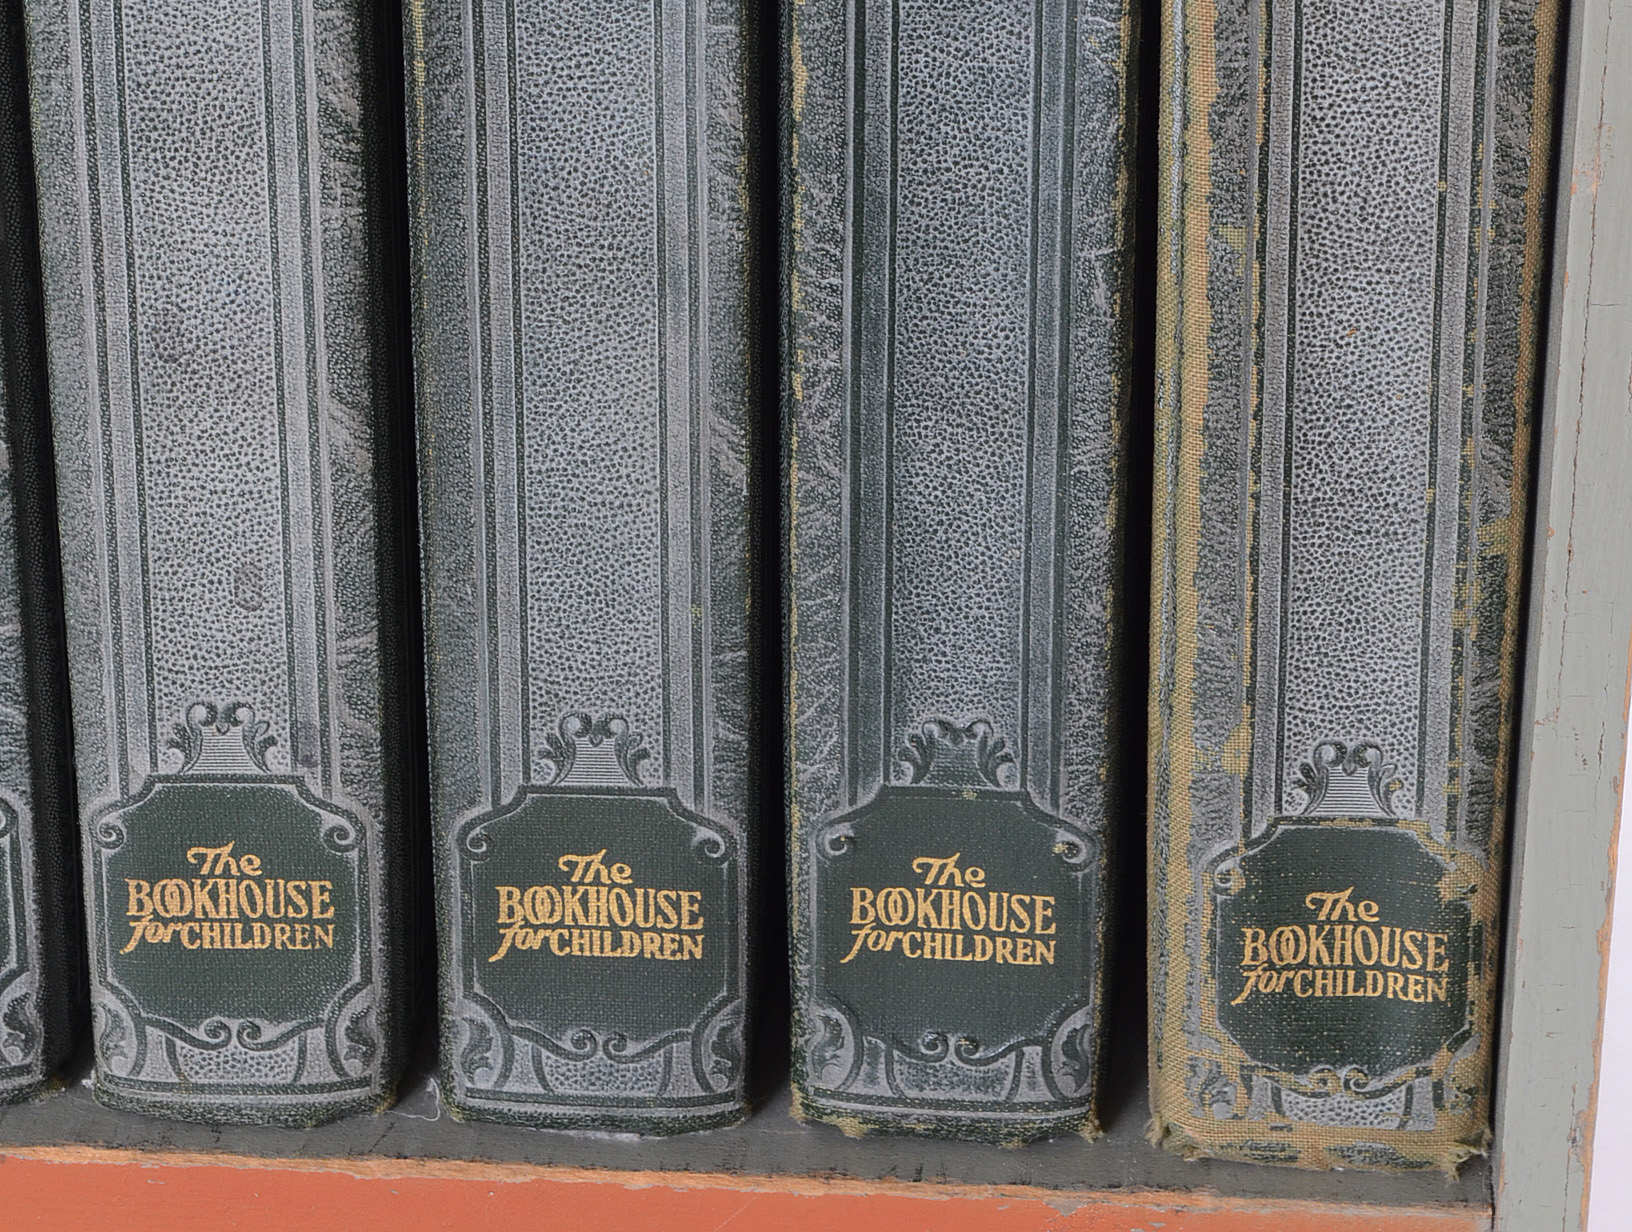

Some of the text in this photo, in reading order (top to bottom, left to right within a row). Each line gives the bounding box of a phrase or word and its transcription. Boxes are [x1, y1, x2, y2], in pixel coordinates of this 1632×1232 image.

[186, 841, 262, 876] The
[558, 849, 633, 884] The
[912, 852, 987, 888] The
[1305, 886, 1380, 922] The
[180, 922, 335, 950] CHILDREN
[549, 928, 704, 960] CHILDREN
[902, 932, 1057, 965] CHILDREN
[1293, 969, 1449, 1003] CHILDREN
